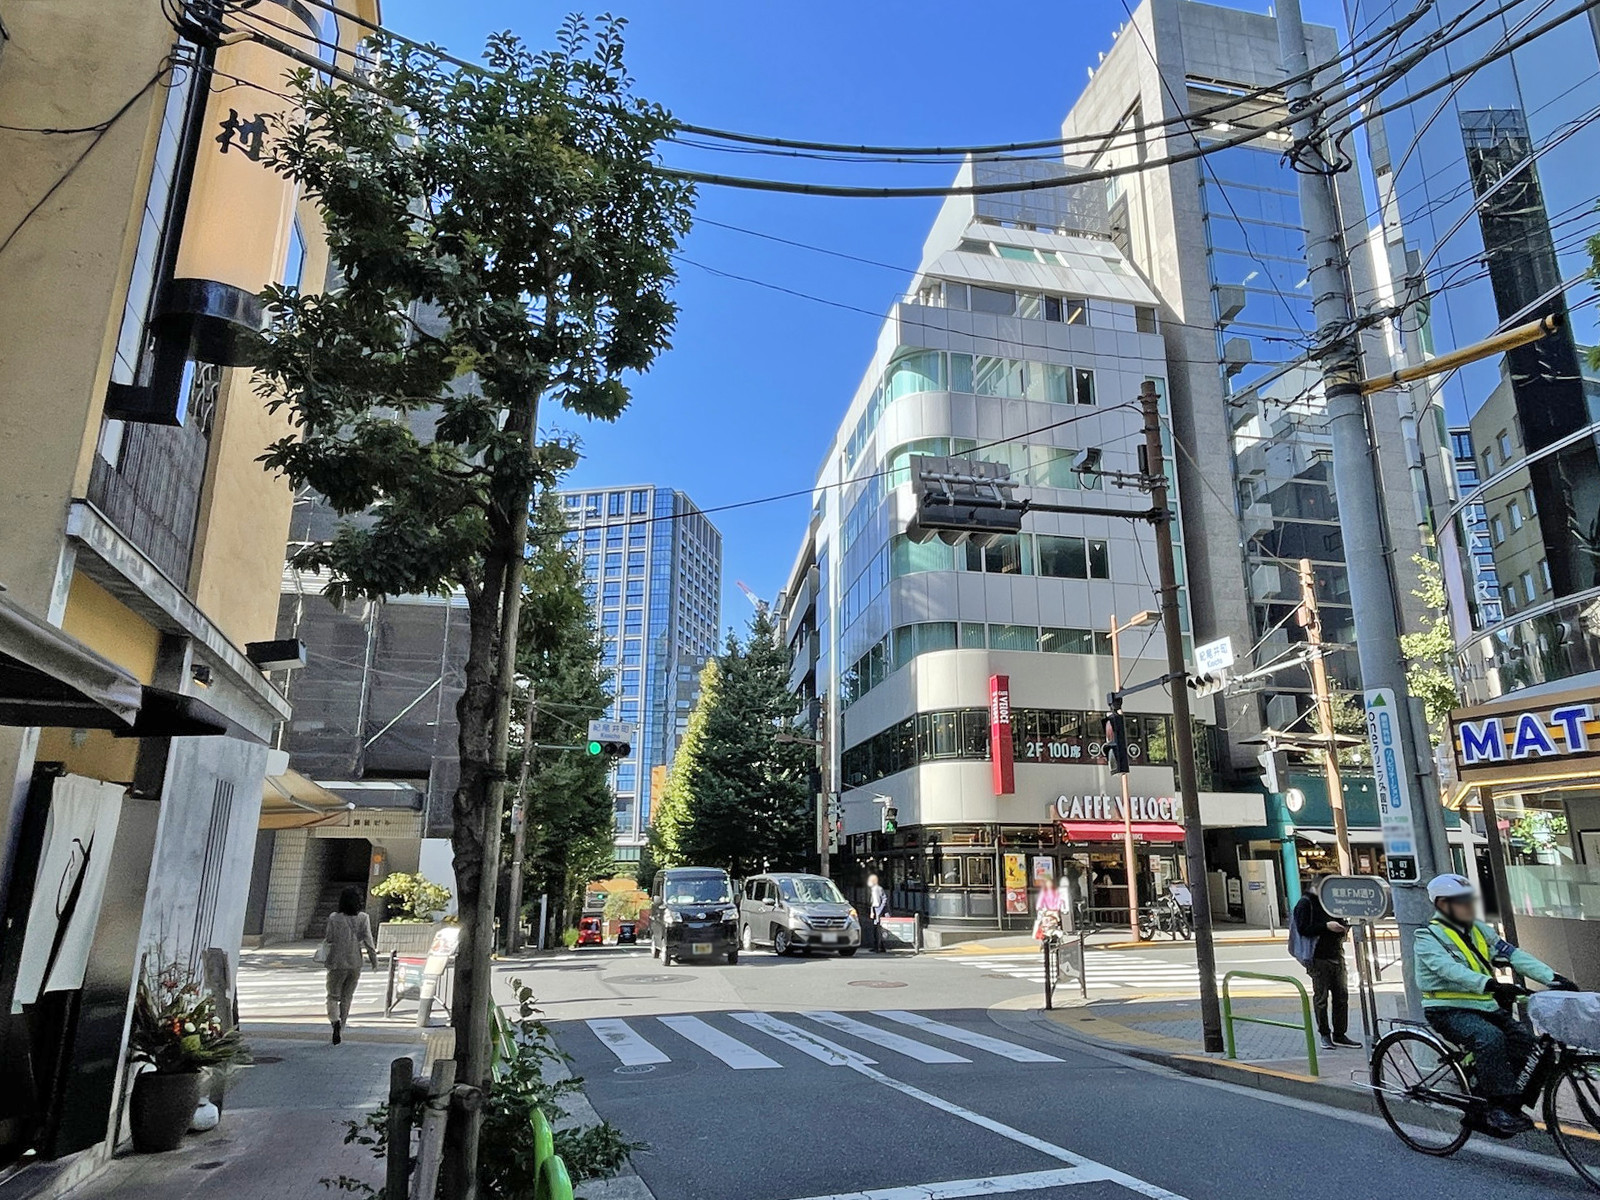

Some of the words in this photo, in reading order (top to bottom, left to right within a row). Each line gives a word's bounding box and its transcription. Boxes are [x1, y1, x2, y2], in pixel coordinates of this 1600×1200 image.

[1459, 704, 1600, 765] MAT
[1026, 741, 1044, 758] 2F
[1047, 742, 1081, 758] 100席
[1331, 887, 1375, 899] 東京FM通り
